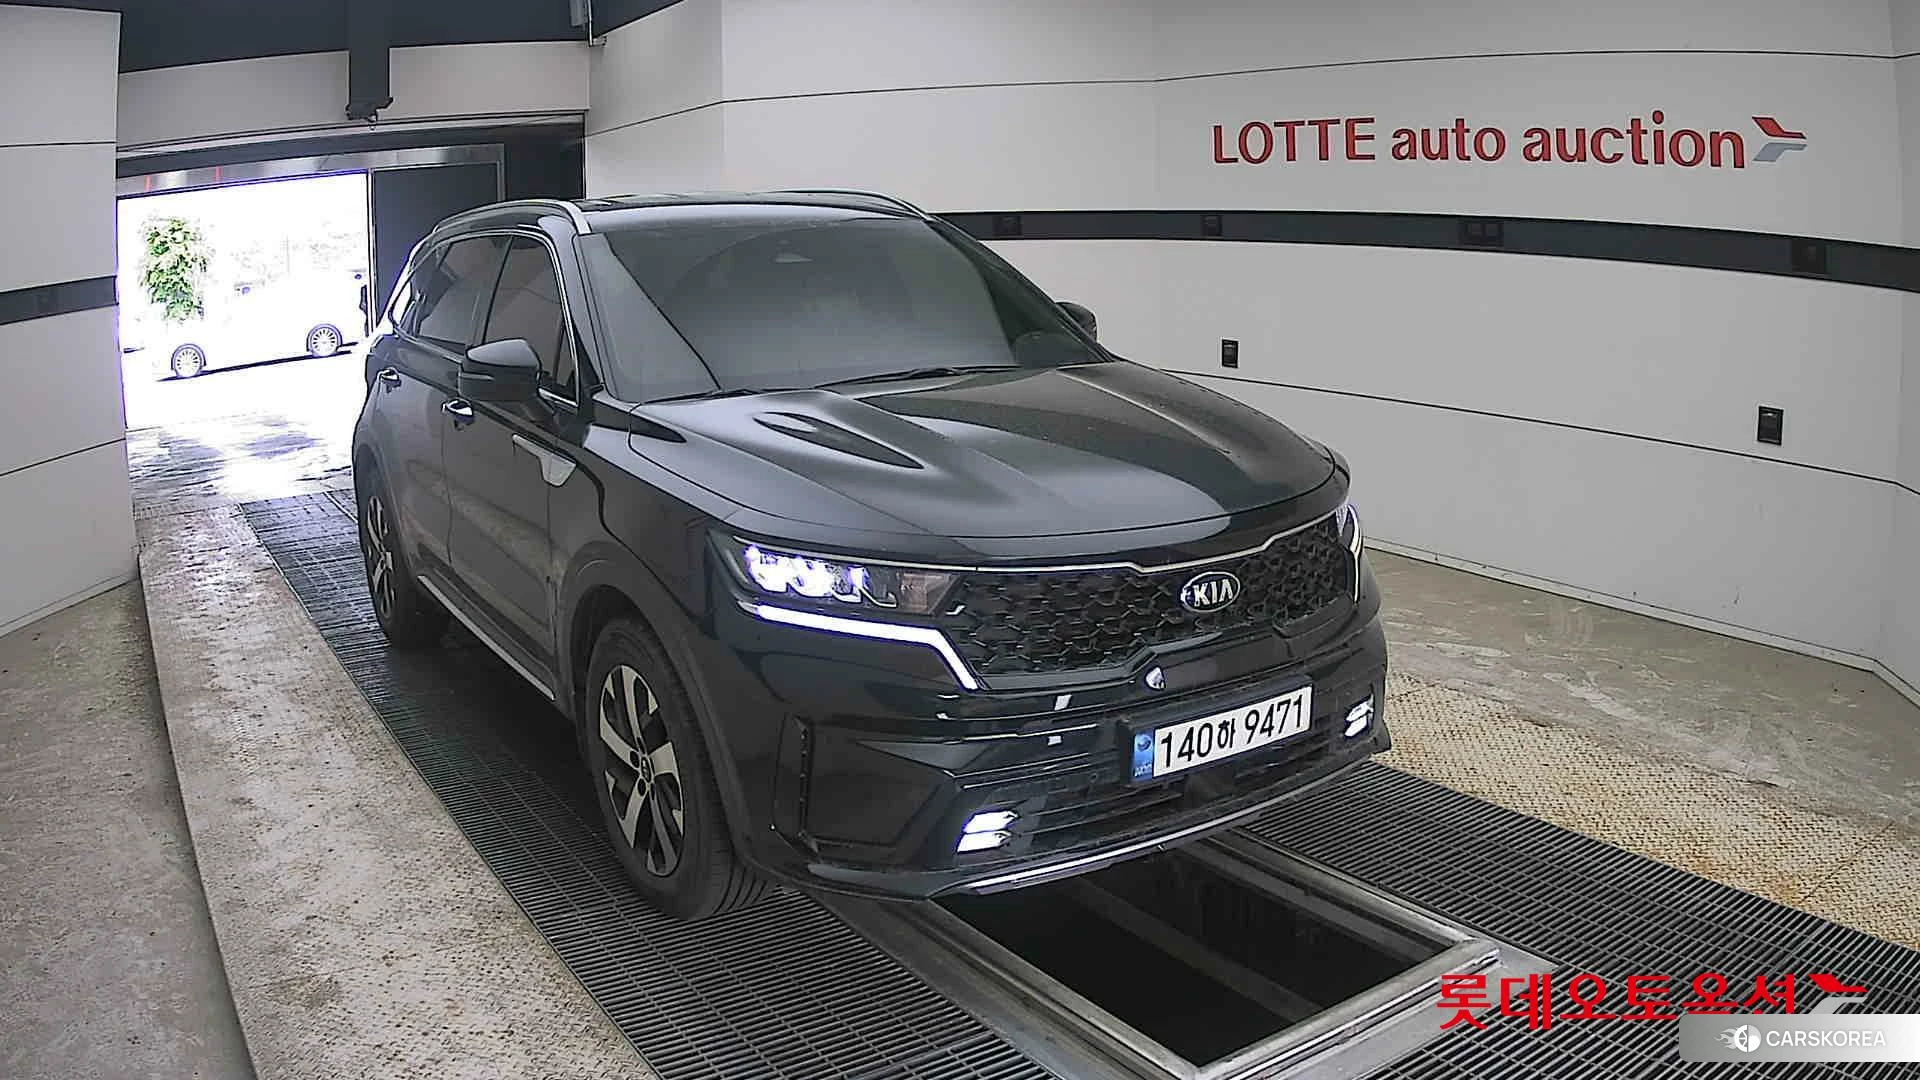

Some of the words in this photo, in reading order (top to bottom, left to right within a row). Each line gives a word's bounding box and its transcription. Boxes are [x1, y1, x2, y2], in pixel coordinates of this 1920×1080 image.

[1213, 118, 1376, 164] LOTTE
[1391, 118, 1507, 162] auto
[1522, 110, 1746, 169] auction
[1193, 579, 1233, 607] KIA
[1160, 718, 1236, 768] 140하
[1244, 694, 1303, 744] 9471
